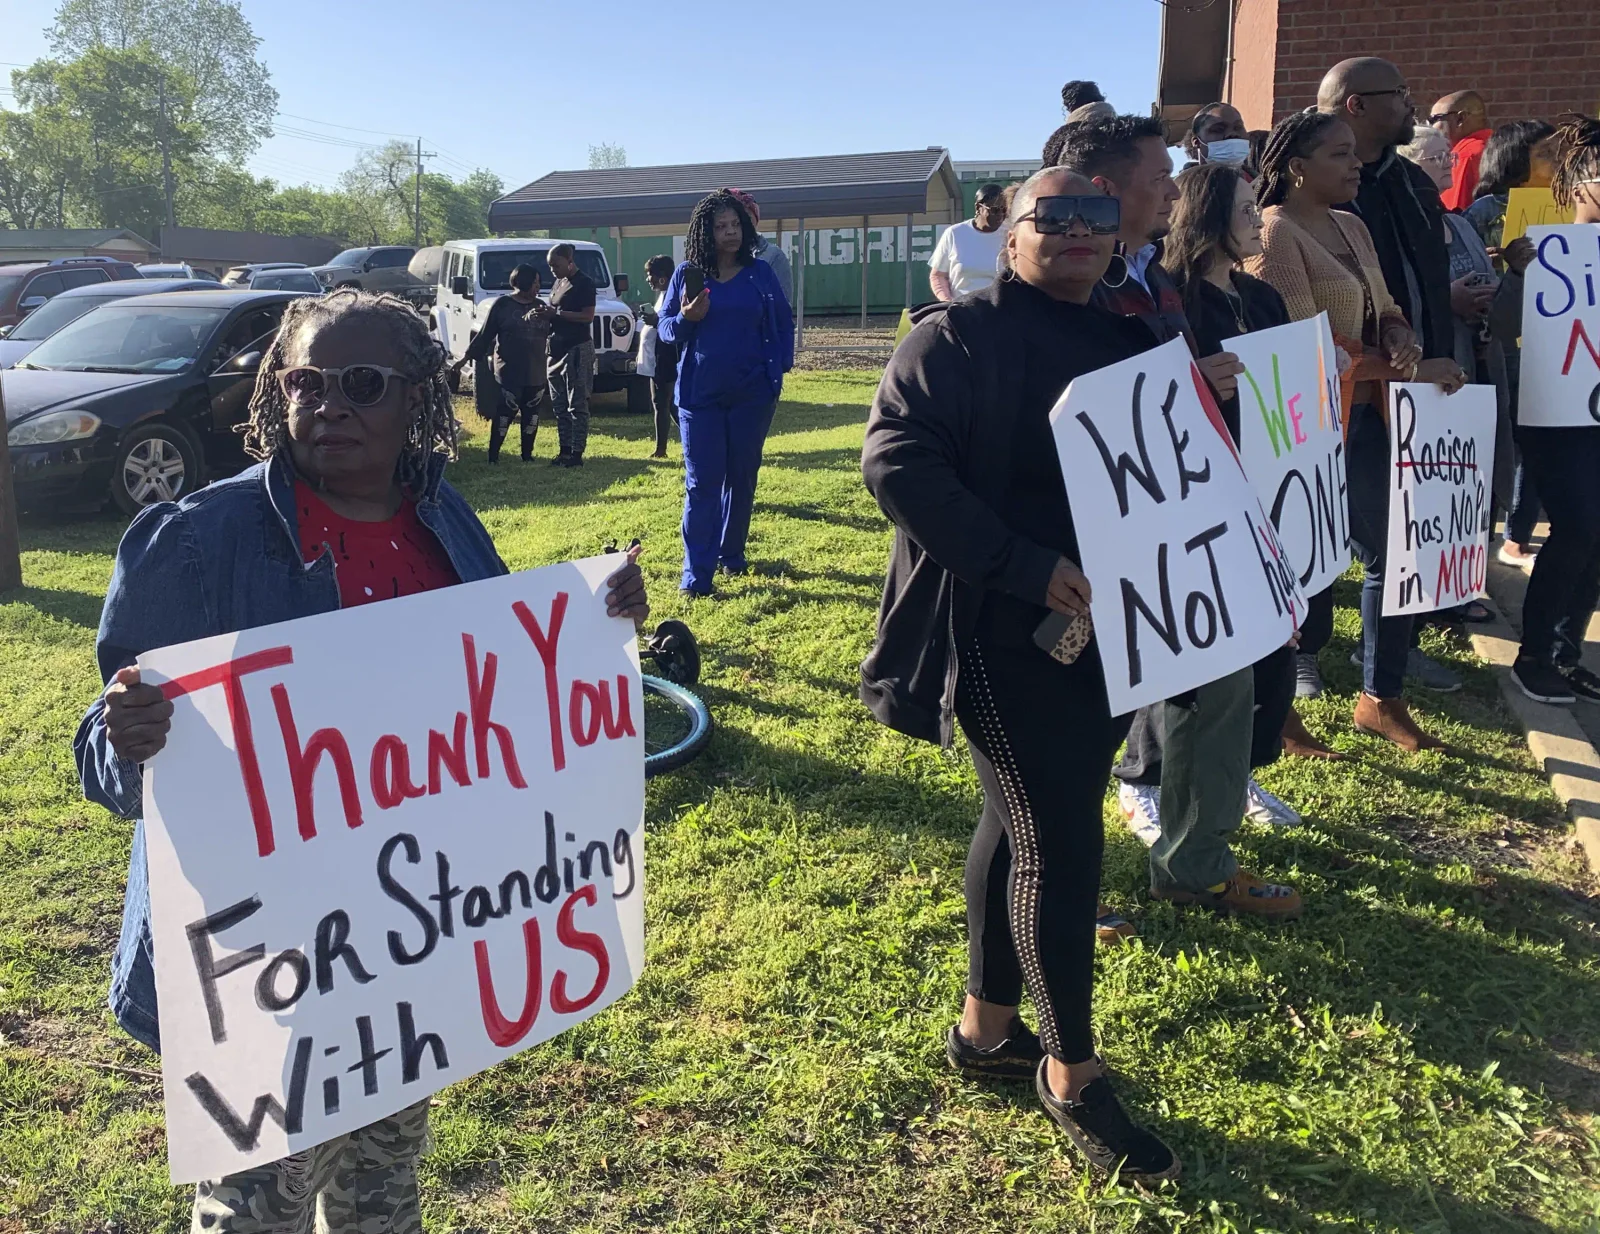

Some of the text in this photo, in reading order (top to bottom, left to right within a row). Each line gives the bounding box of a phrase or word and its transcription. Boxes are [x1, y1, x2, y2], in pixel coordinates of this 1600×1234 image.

[1536, 233, 1600, 318] Si
[1075, 372, 1211, 519] WE
[1244, 353, 1307, 459] WE
[1395, 387, 1478, 490] Racism
[1269, 442, 1350, 589] ONE
[1404, 489, 1444, 551] has
[1399, 566, 1423, 609] in
[511, 591, 637, 773] You
[377, 811, 636, 966] Standing
[185, 884, 611, 1153] With US
